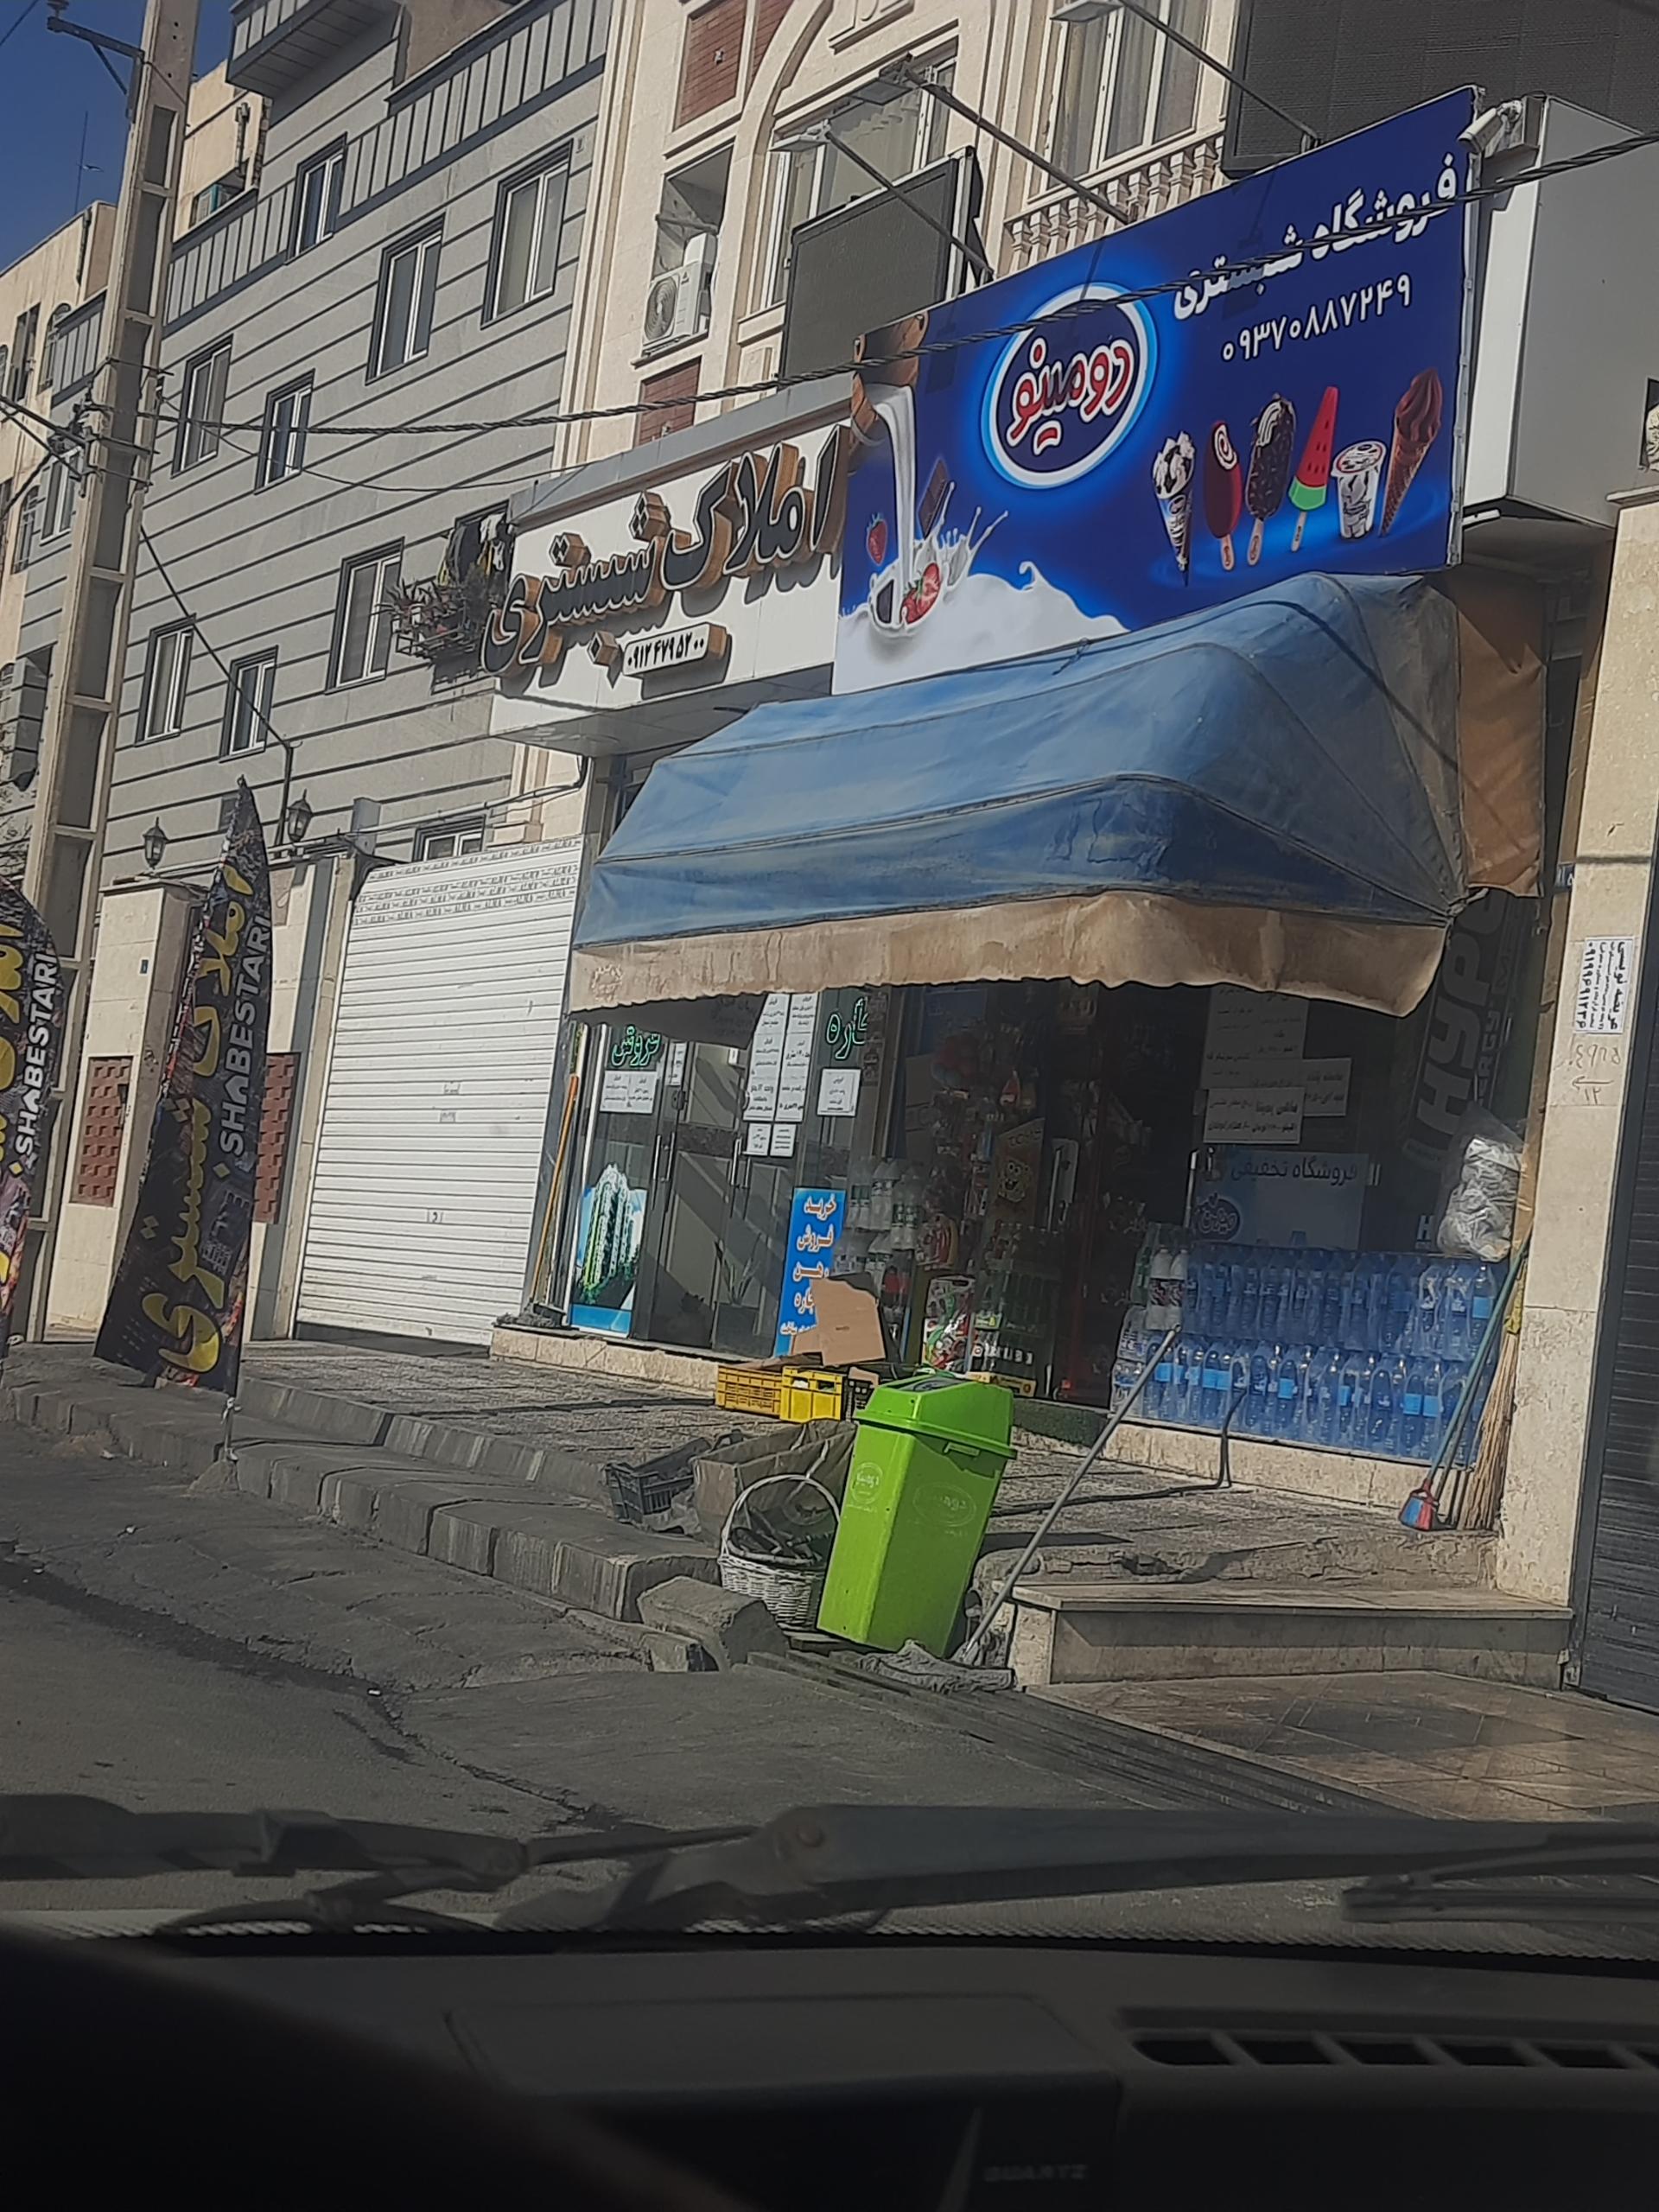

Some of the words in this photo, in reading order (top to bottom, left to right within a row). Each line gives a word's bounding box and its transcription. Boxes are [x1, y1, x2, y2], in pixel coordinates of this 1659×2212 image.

[1311, 153, 1459, 260] فروشگاه
[1222, 273, 1412, 361] ۰۹۳۷۰۸۸۷۲۴۹
[1007, 338, 1135, 455] دومینو
[660, 424, 842, 591] املاک
[480, 490, 659, 676] شبستری
[16, 952, 58, 1157] SHABESTARI
[219, 913, 271, 1159] SHABESTARI
[803, 1192, 837, 1220] خرید
[1291, 1156, 1357, 1185] فروشگاه
[797, 1223, 835, 1253] فروش
